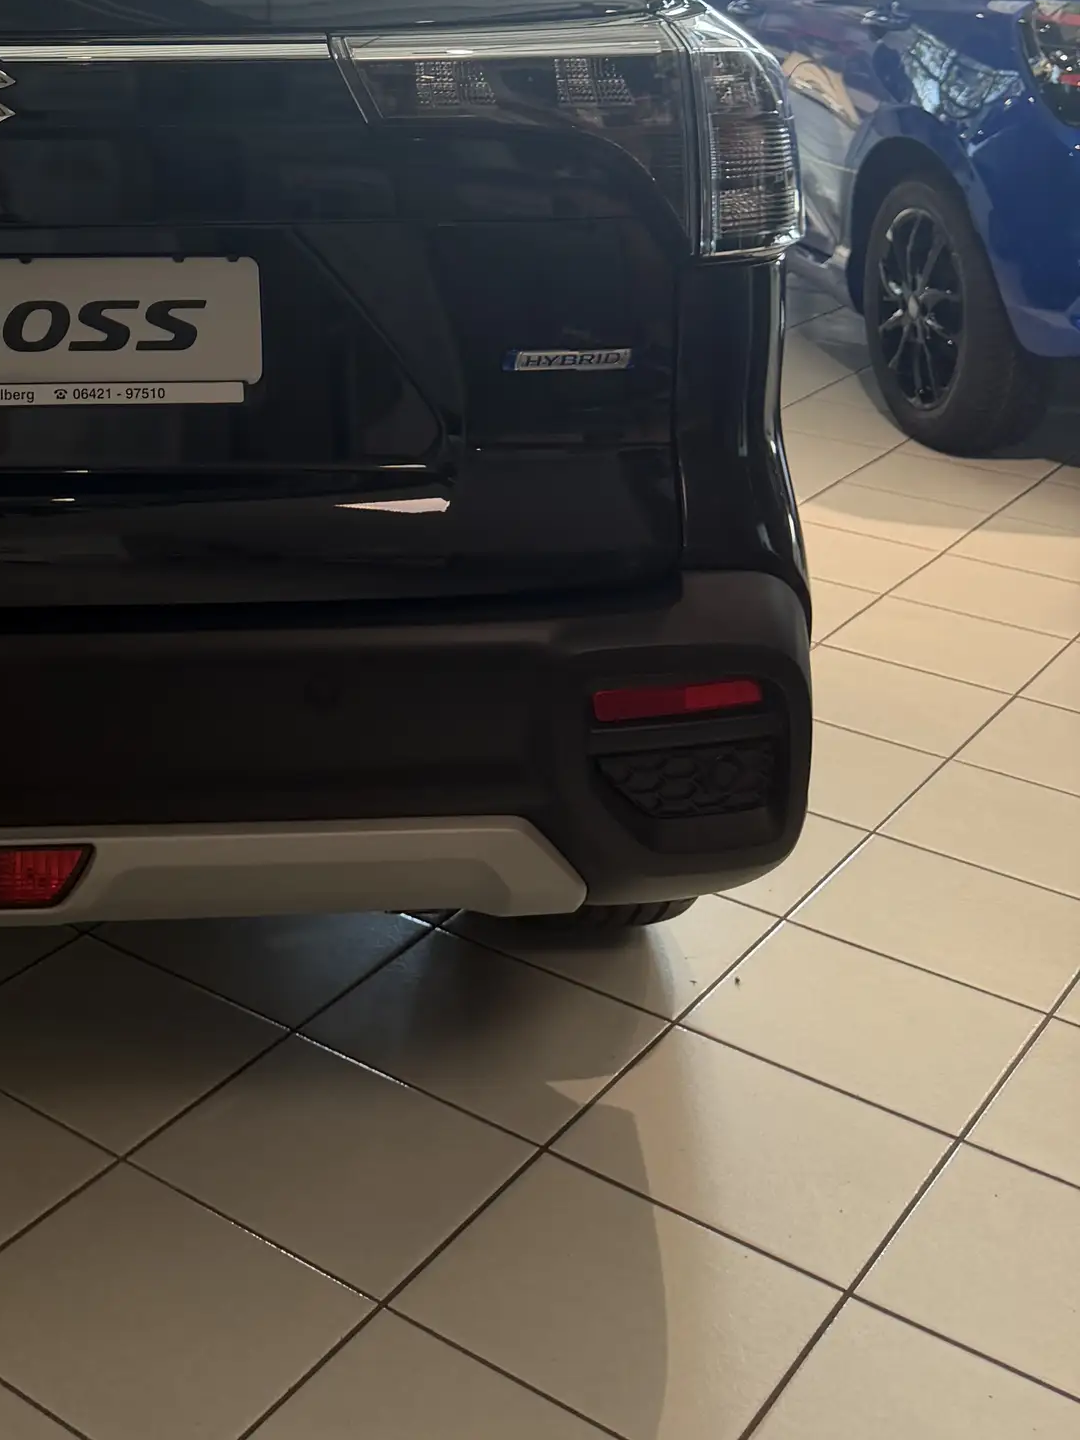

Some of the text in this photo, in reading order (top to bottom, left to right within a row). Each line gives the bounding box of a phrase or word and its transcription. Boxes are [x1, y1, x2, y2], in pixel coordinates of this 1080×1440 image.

[524, 351, 620, 368] HYBRID
[72, 387, 112, 400] 06421
[125, 387, 166, 399] 97510
